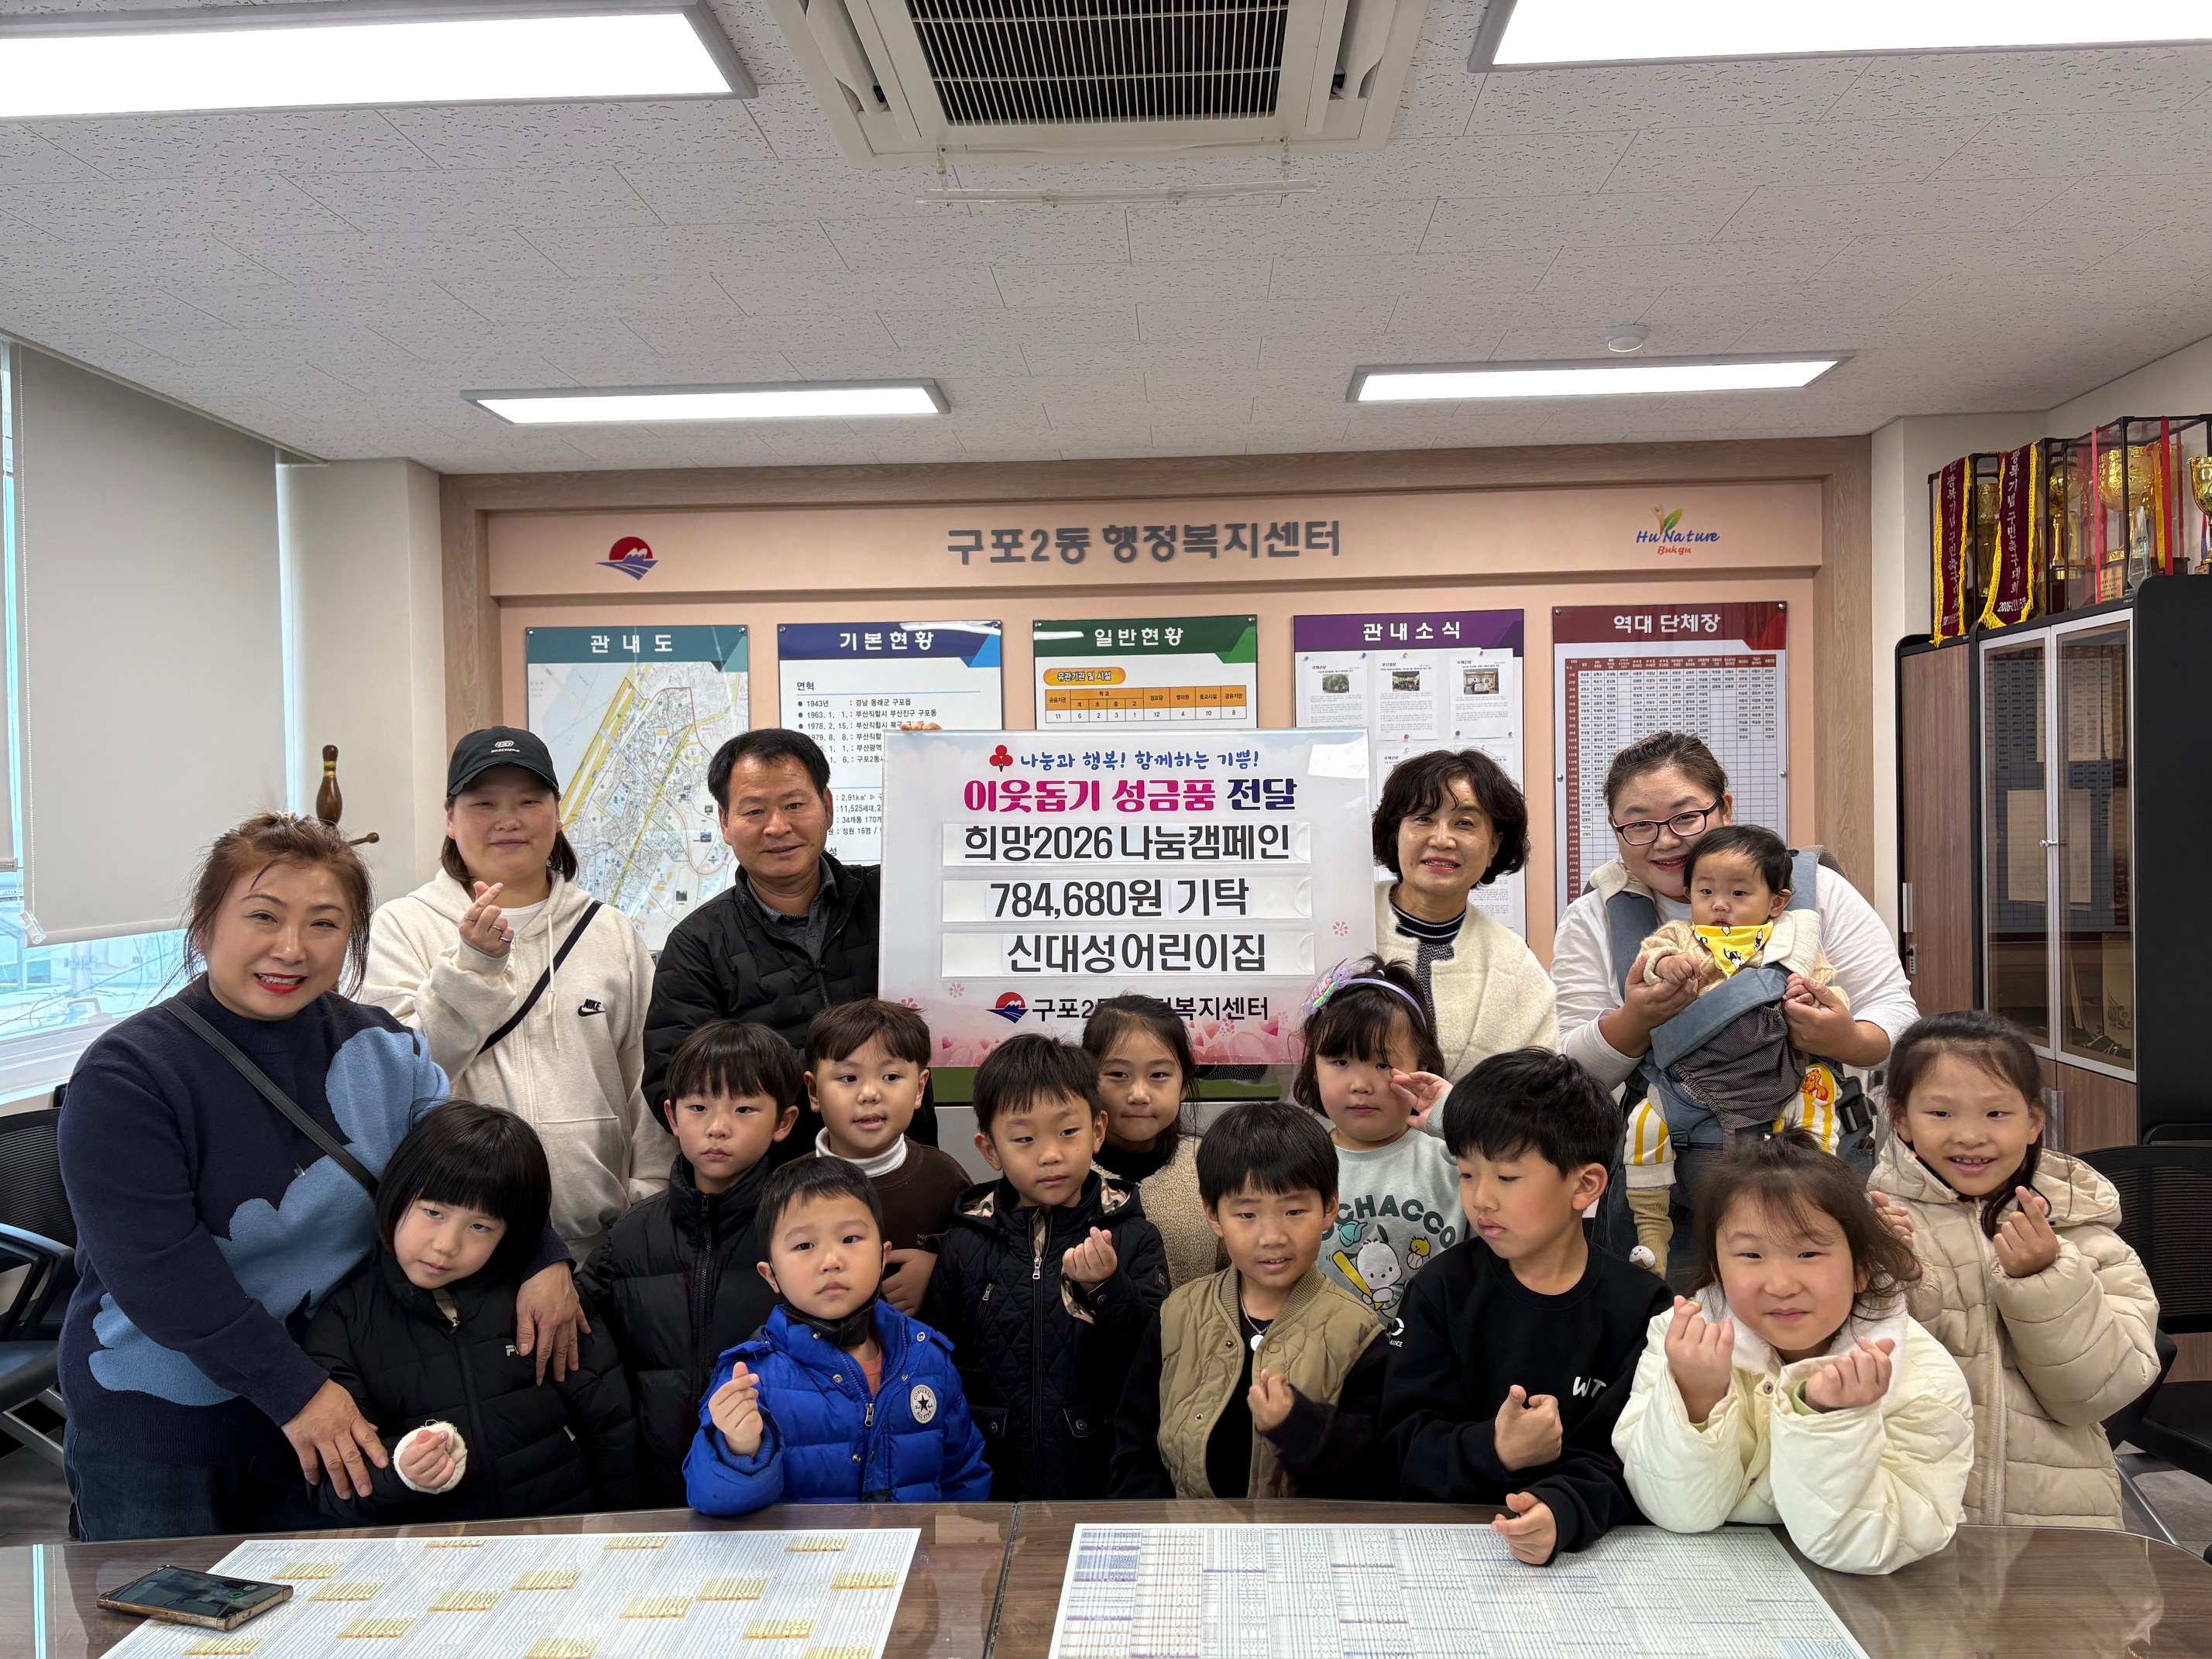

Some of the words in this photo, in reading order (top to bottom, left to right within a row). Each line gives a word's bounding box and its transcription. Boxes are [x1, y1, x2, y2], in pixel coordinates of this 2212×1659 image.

[948, 528, 1091, 565] 구포2동
[1102, 520, 1341, 563] 행정복지센터
[1663, 529, 1720, 544] Nature
[1657, 545, 1692, 555] Bukgu
[1362, 621, 1461, 641] 관내소식
[1613, 614, 1653, 634] 역대
[1660, 613, 1720, 634] 단체장
[840, 630, 934, 651] 기본현황
[1094, 627, 1183, 647] 일반현황
[796, 682, 814, 691] 연혁
[1057, 672, 1085, 682] 유관기관
[1087, 671, 1095, 681] 및
[1097, 671, 1111, 681] 시설
[1020, 752, 1075, 771] 나눔과
[1082, 750, 1125, 771] 행복!
[1135, 750, 1209, 770] 함께하는
[1217, 750, 1259, 769] 기쁨!
[963, 778, 1101, 812] 이웃돕기
[1112, 778, 1216, 812] 성금품
[1227, 778, 1297, 811] 전달
[965, 824, 1113, 861] 희망2026
[1121, 824, 1290, 861] 나눔캠페인
[990, 879, 1161, 920] 784,680원
[1176, 878, 1249, 916] 기탁
[1007, 933, 1266, 974] 신대성어린이집
[1152, 996, 1269, 1021] 복지센터
